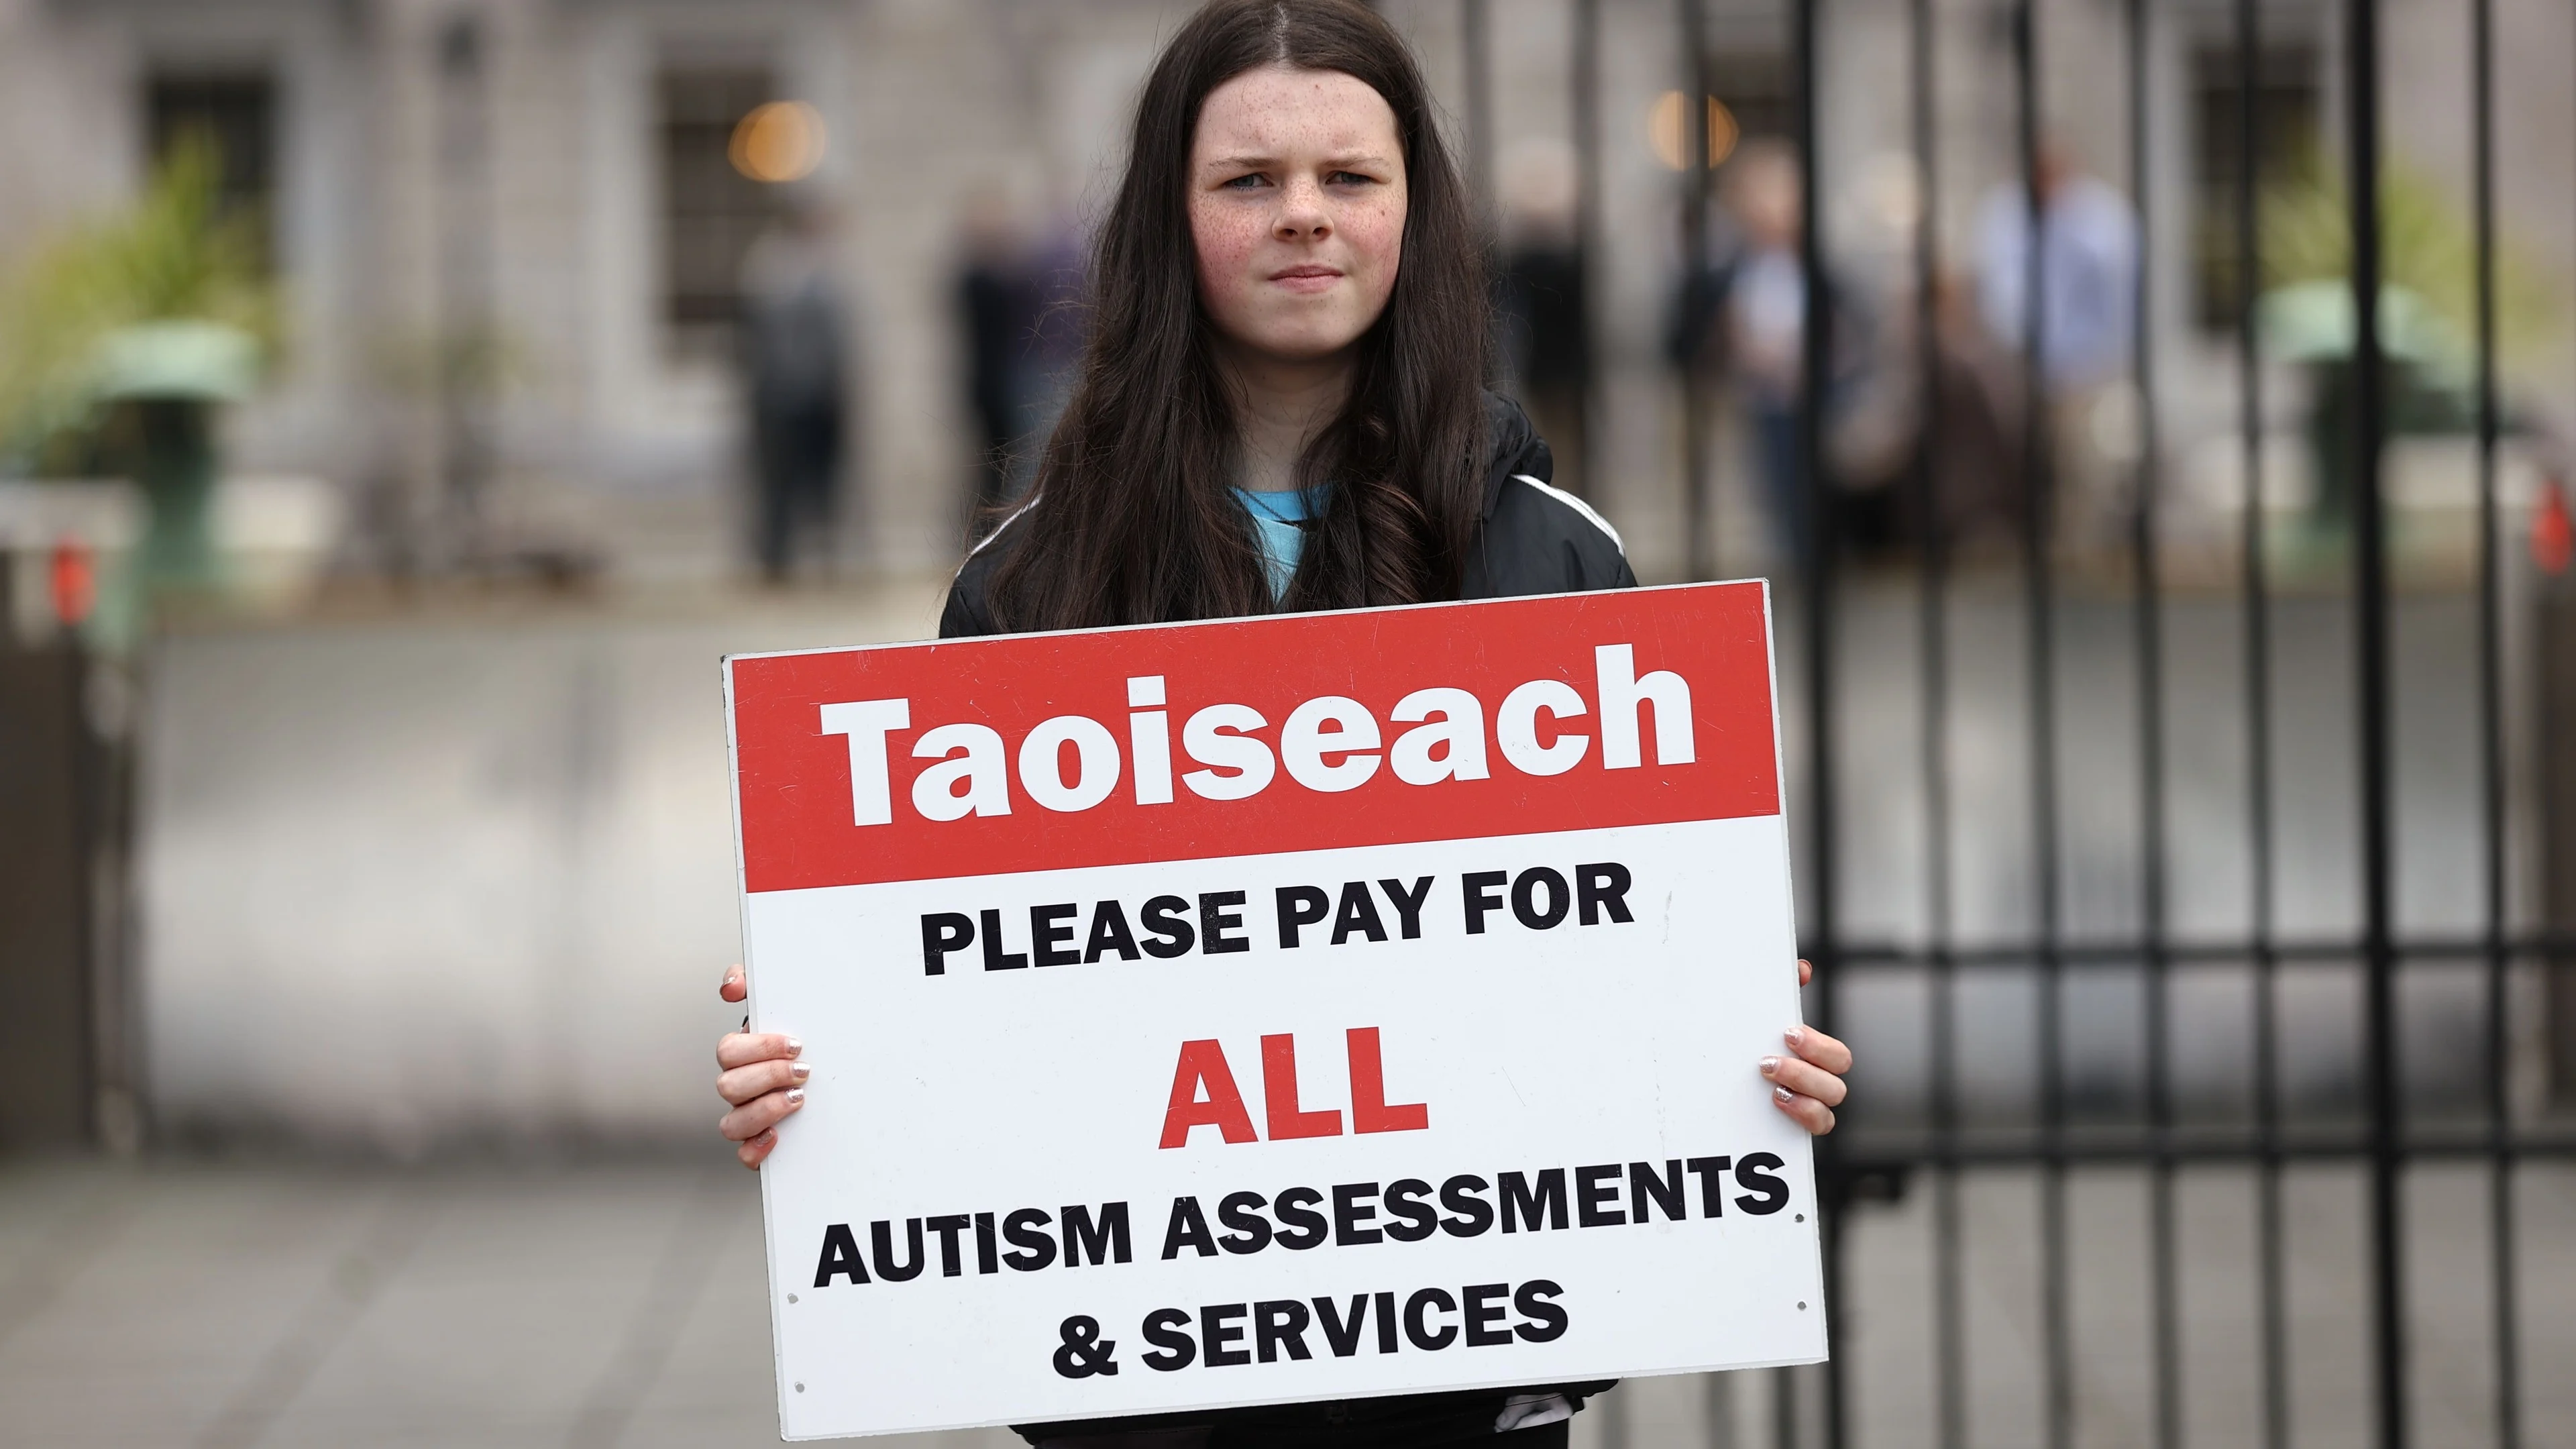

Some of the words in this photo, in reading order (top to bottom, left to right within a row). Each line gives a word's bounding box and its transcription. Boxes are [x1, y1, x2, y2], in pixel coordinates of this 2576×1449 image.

[820, 643, 1696, 826] Taoiseach
[920, 890, 1250, 976] PLEASE
[1275, 875, 1436, 949] PAY
[1461, 862, 1635, 935] FOR
[1159, 1026, 1428, 1150] ALL
[813, 1201, 1132, 1288] AUTISM
[1161, 1152, 1790, 1260] ASSESSMENTS
[1053, 1315, 1119, 1379] &
[1141, 1279, 1568, 1372] SERVICES
